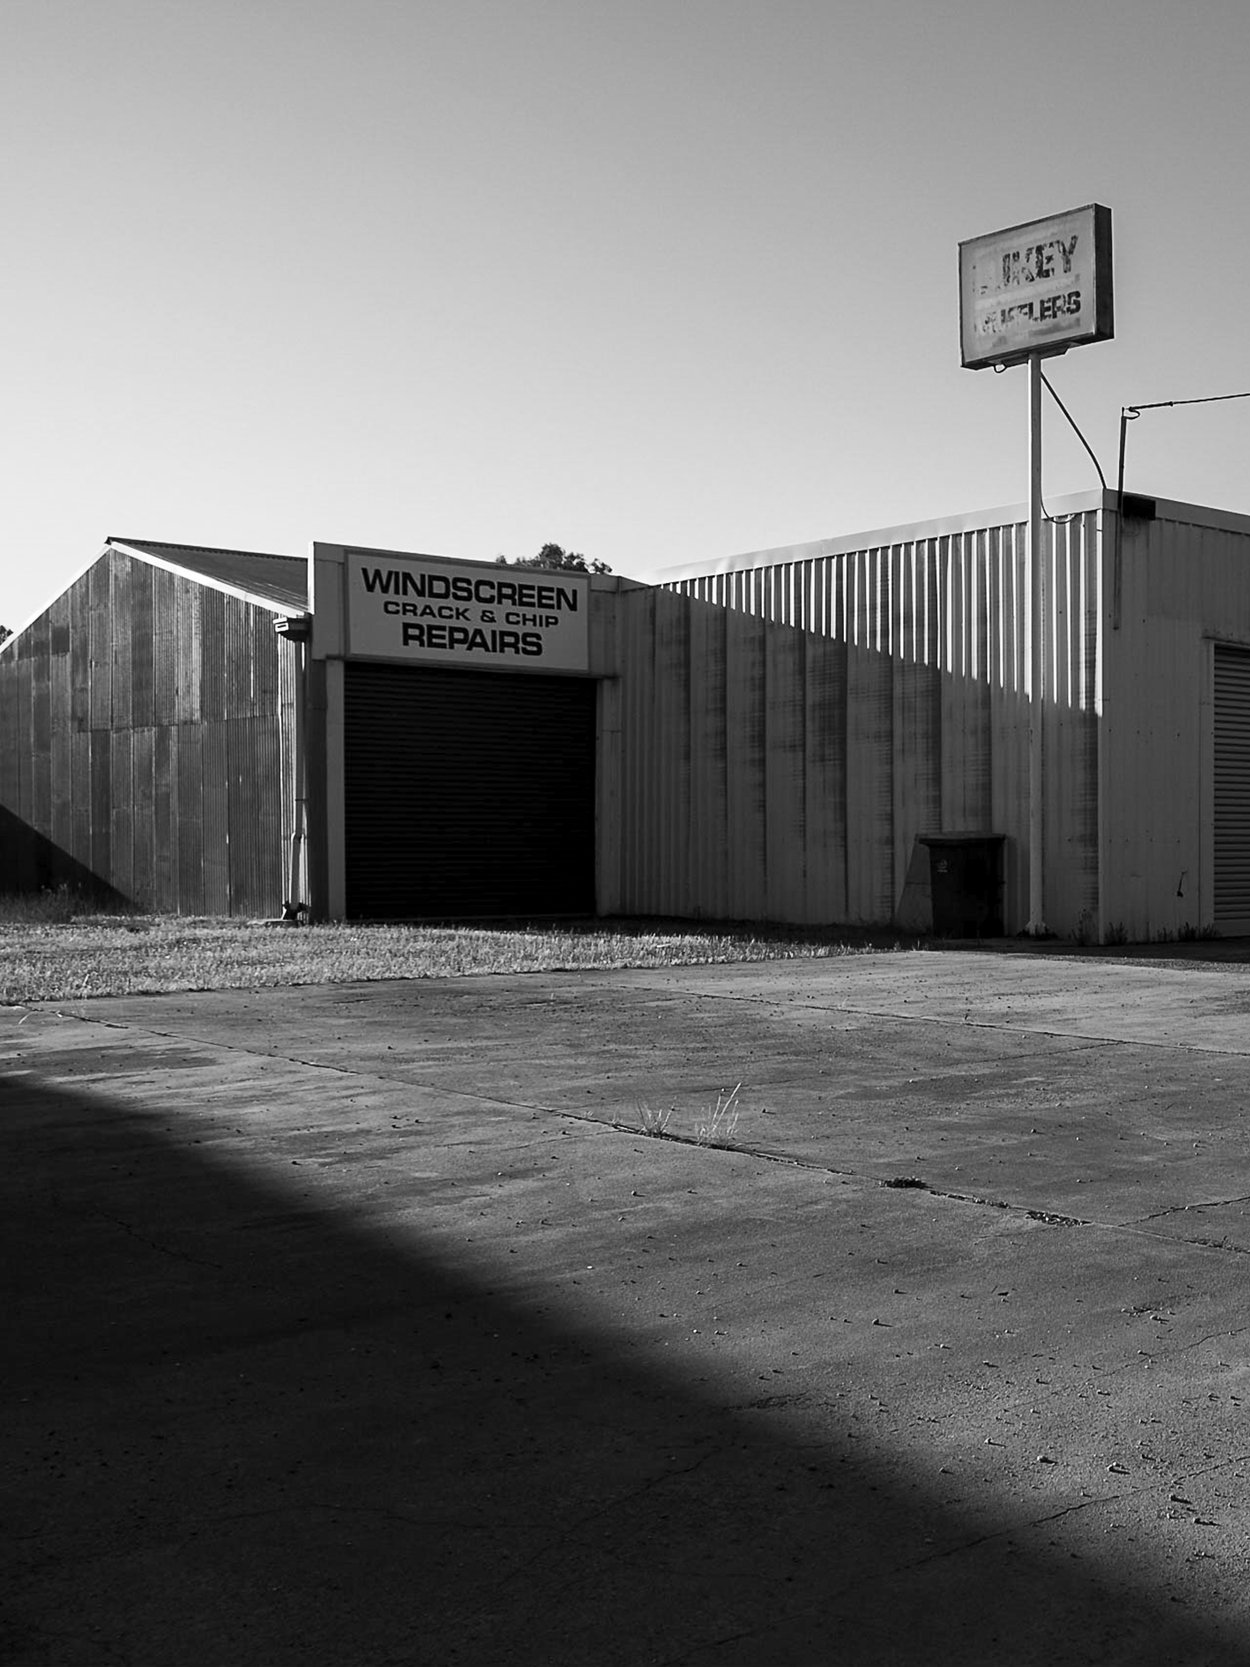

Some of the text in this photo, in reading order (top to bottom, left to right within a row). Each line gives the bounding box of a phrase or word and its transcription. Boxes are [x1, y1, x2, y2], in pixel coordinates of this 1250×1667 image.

[361, 567, 578, 612] WINDSCREEN
[383, 600, 559, 628] CRACK & CHIP
[402, 622, 543, 656] REPAIRS
